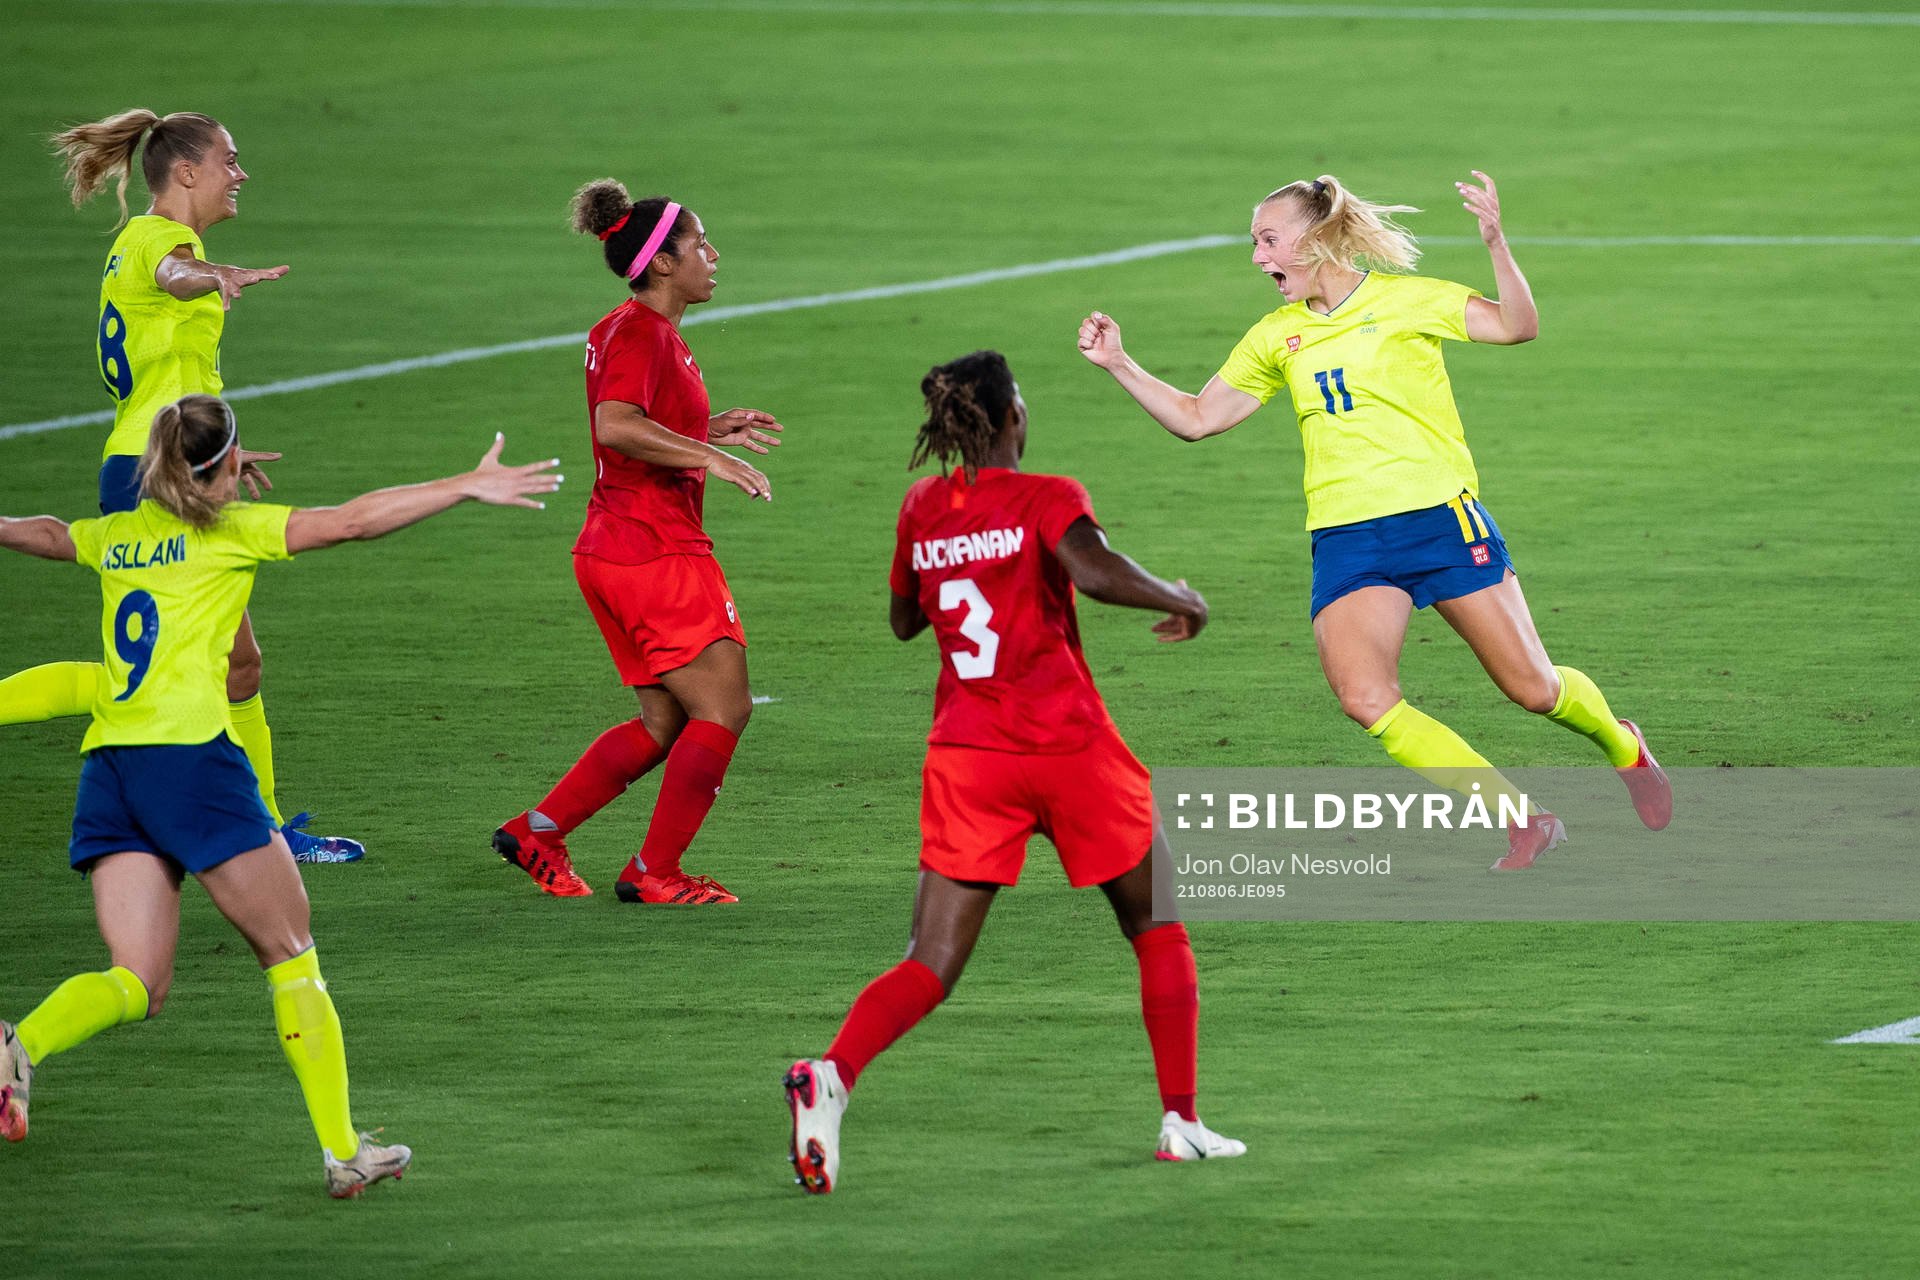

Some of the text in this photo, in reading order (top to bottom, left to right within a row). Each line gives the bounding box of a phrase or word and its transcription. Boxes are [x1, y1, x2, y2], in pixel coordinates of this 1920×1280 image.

[99, 299, 134, 400] 8
[1314, 367, 1354, 415] 11
[1446, 493, 1490, 544] 11
[114, 589, 159, 701] 9
[939, 578, 1000, 680] 3
